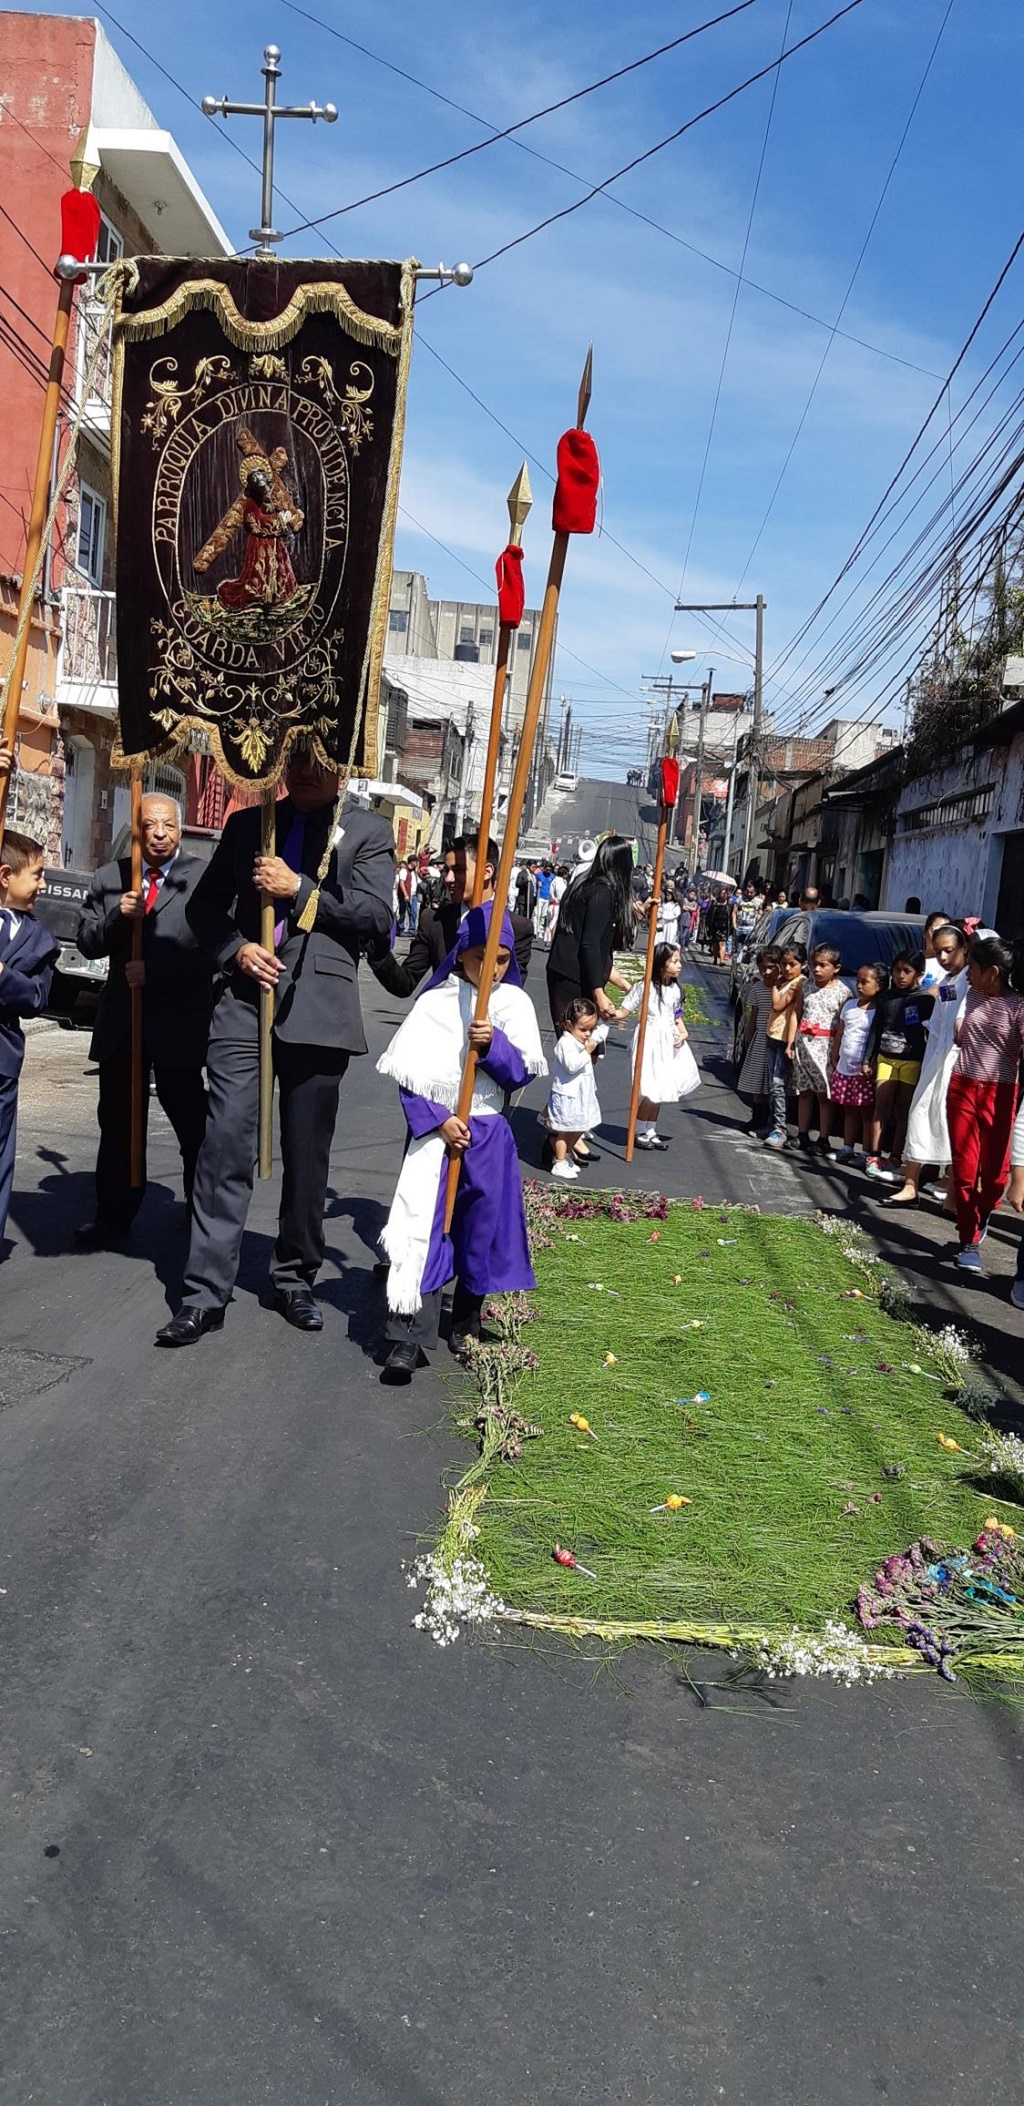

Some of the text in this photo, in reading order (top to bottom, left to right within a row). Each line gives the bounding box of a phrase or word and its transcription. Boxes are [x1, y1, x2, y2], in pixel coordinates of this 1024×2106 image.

[155, 384, 346, 549] PARROQUIA DIVINA PROVIDENCIA
[172, 600, 325, 668] GUARDA VIEJO
